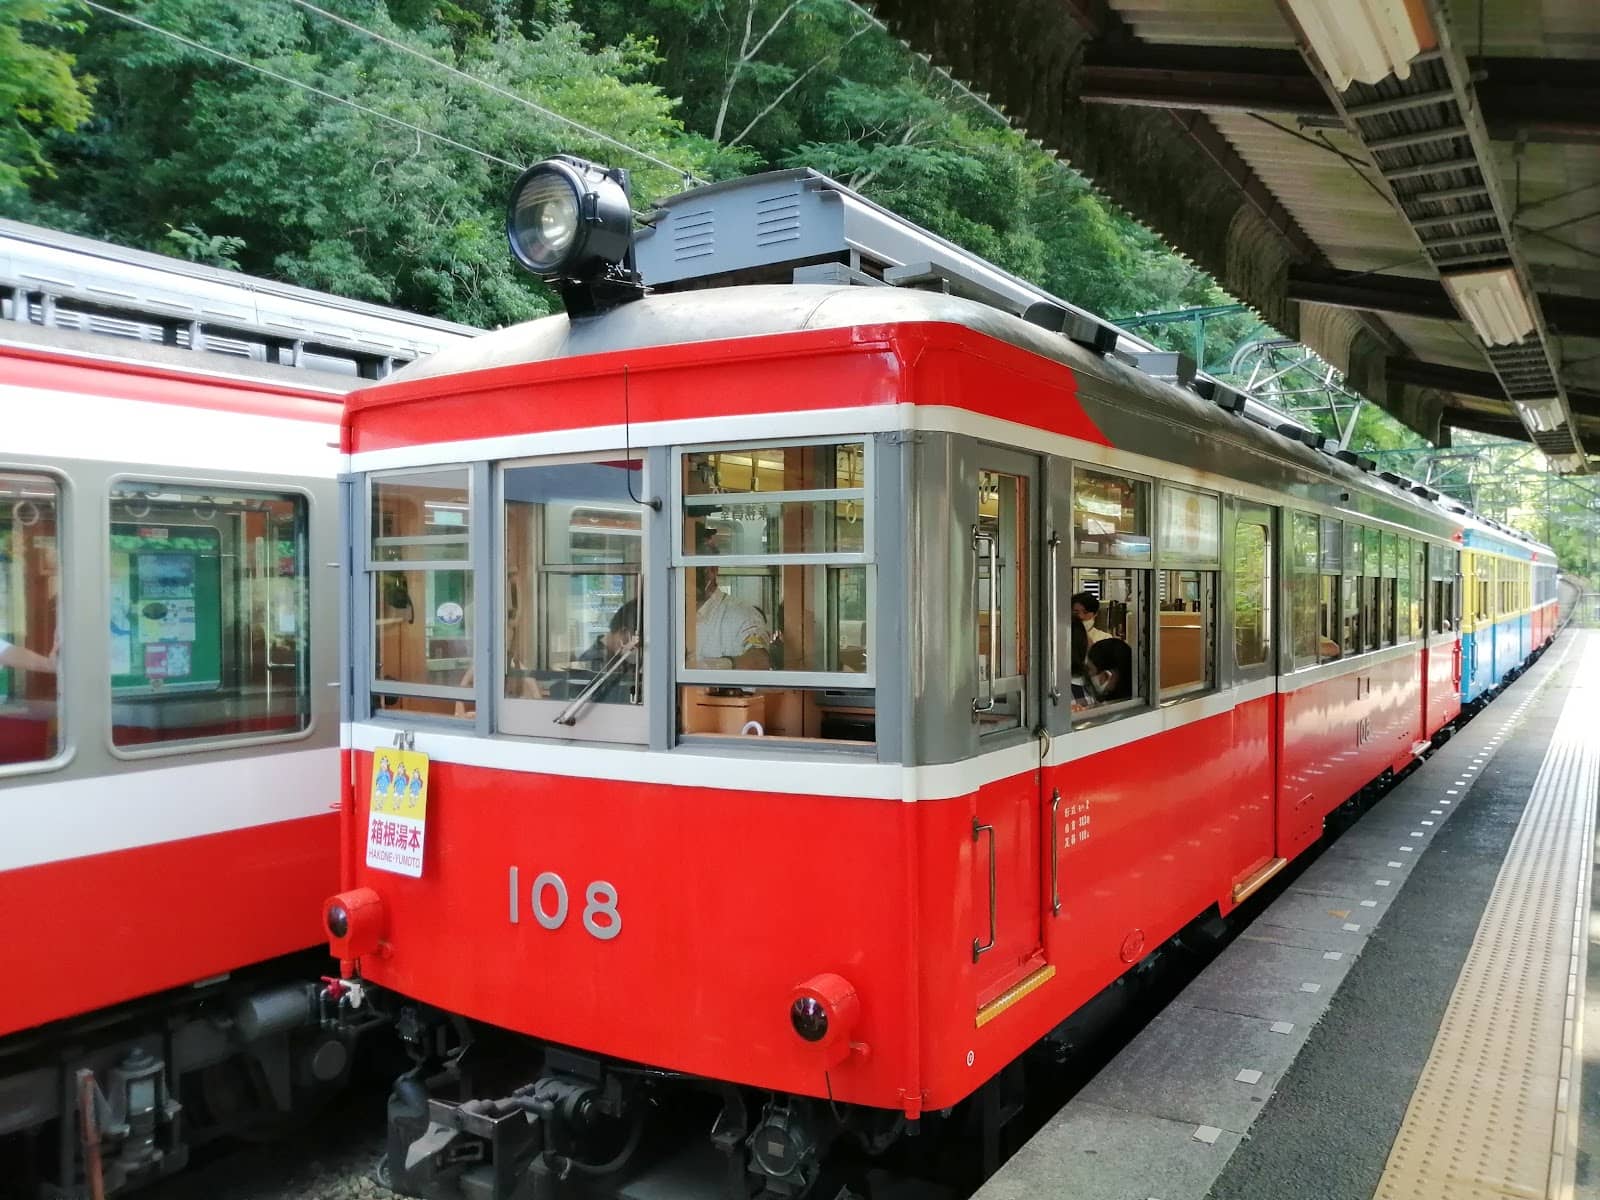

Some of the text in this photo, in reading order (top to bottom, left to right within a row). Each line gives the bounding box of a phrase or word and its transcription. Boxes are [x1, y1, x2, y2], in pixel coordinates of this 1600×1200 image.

[370, 819, 421, 853] 箱根湯本
[368, 848, 421, 869] HAKONE-YUMOTO
[509, 866, 622, 940] 108
